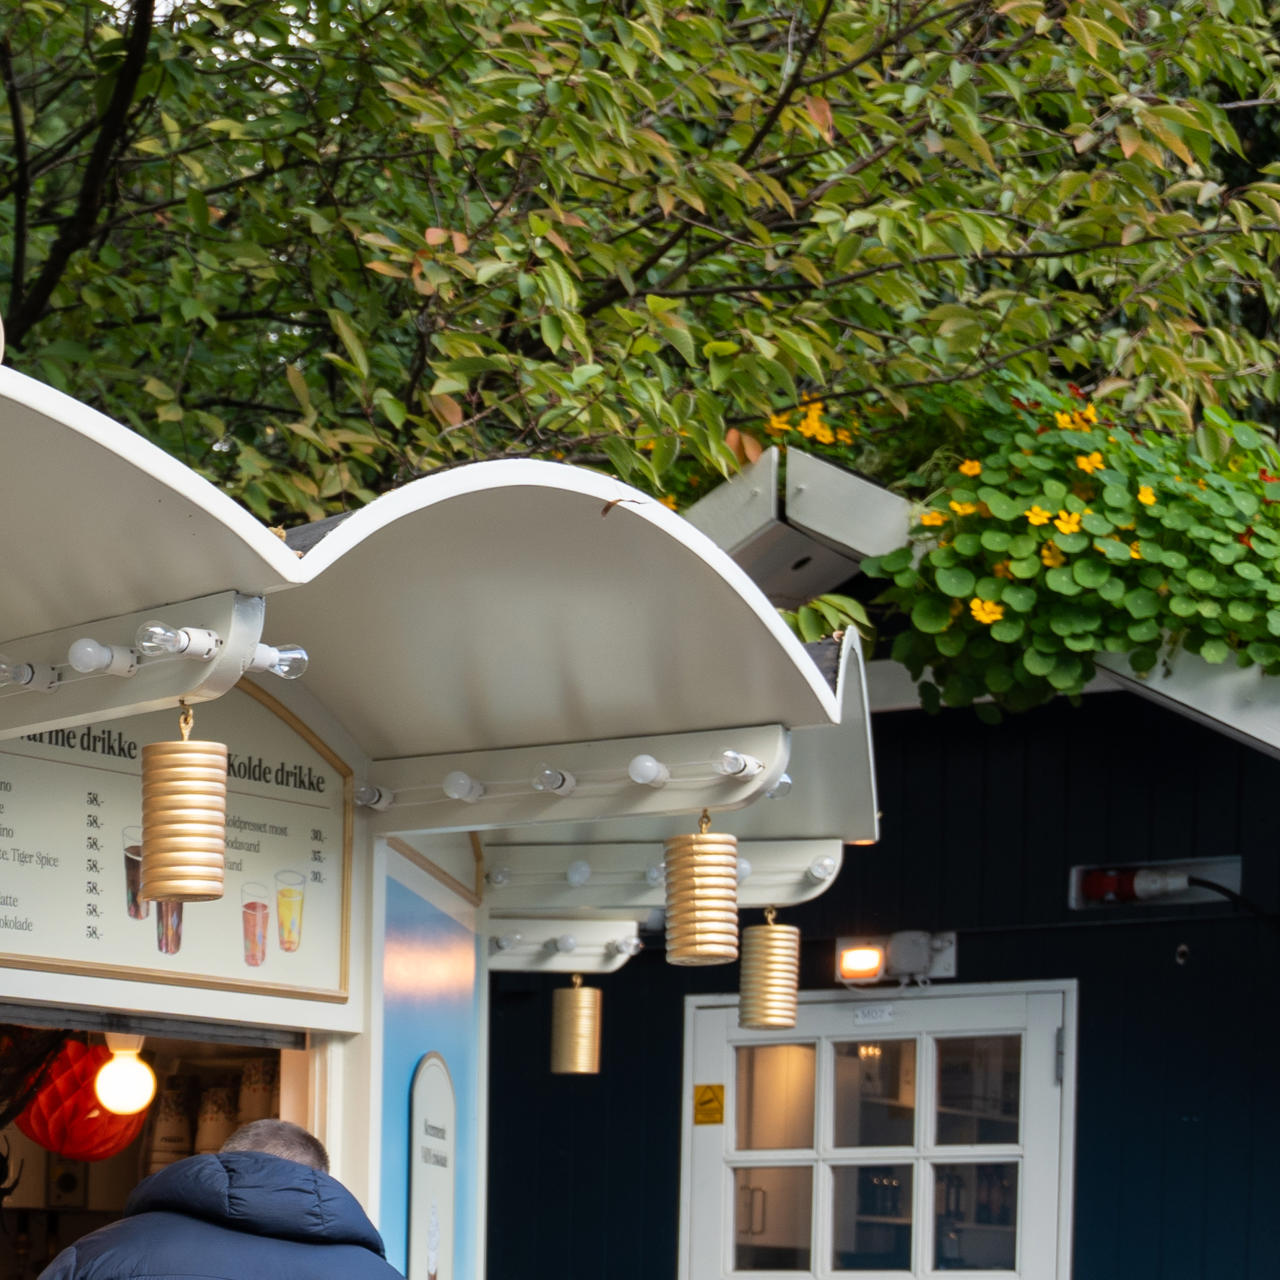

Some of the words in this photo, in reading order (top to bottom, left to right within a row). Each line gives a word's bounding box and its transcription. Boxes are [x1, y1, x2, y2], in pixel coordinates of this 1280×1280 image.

[80, 726, 137, 759] drikke
[227, 754, 271, 783] Kolde
[275, 763, 325, 792] drikke
[11, 848, 34, 866] Tiger
[36, 852, 58, 868] Spice
